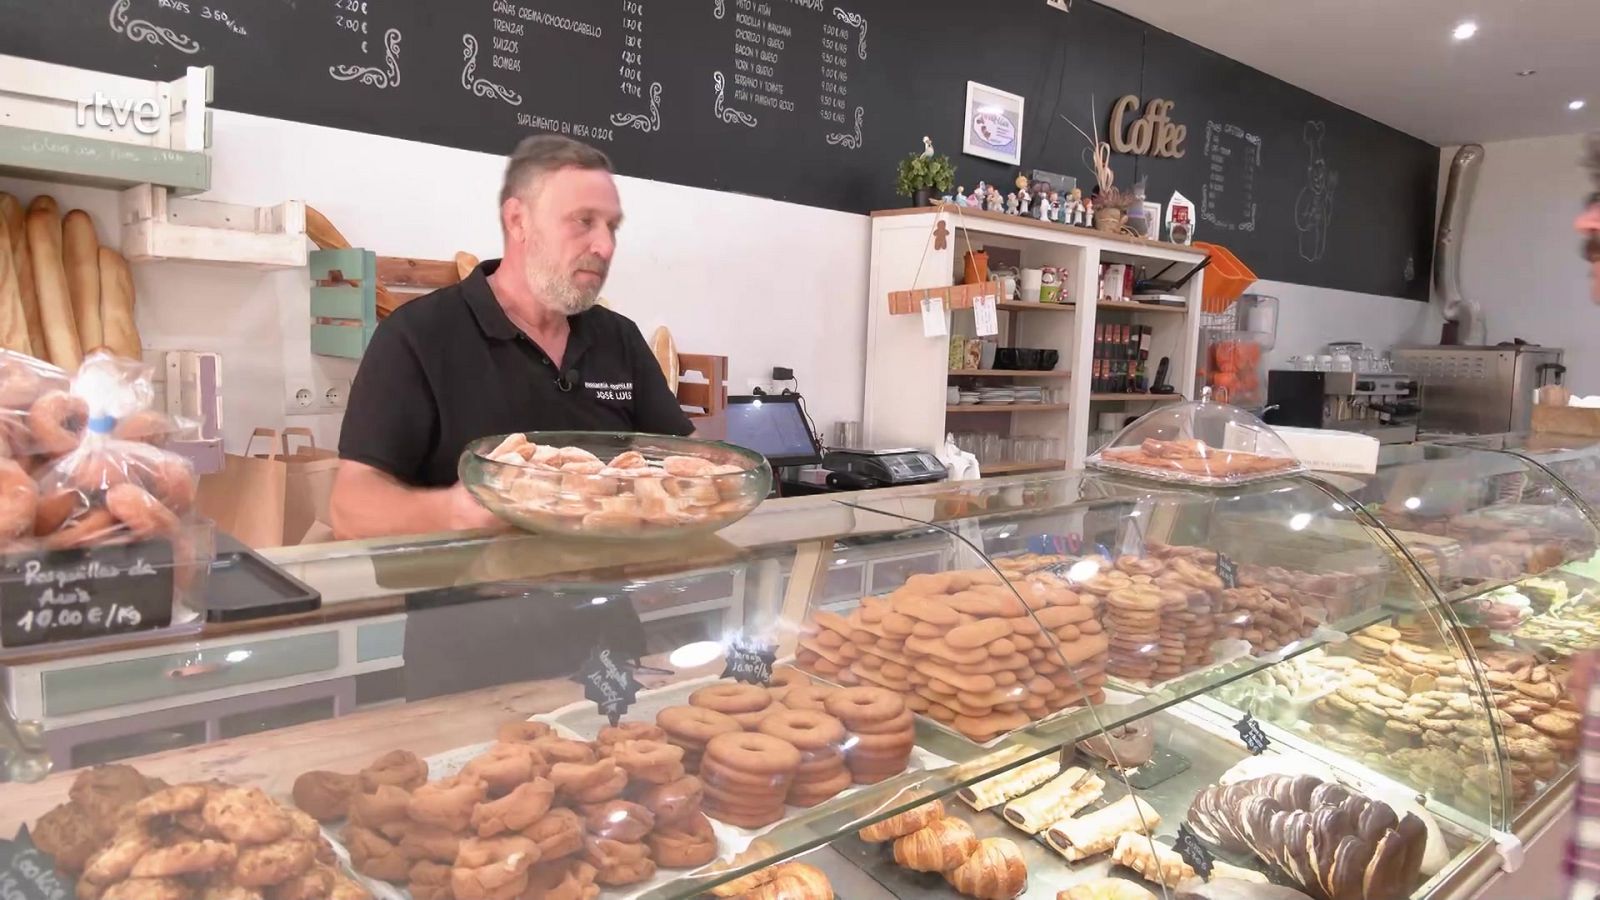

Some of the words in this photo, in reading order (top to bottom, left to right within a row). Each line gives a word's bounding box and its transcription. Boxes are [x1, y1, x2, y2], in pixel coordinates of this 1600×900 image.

[493, 0, 515, 16] CAÑAS
[753, 2, 757, 12] Y
[493, 18, 524, 36] TRENZAS
[762, 21, 766, 29] Y
[493, 37, 518, 53] SUIZOS
[735, 28, 760, 43] CHORIZO
[762, 36, 766, 45] Y
[767, 37, 784, 50] QUESO
[735, 43, 753, 57] BACON
[755, 49, 759, 58] Y
[760, 50, 778, 63] QUESO
[493, 55, 520, 72] BOMBAS
[735, 58, 748, 71] YORK
[750, 63, 754, 72] Y
[755, 64, 773, 77] QUESO
[517, 113, 559, 132] SUPLEMENTO
[561, 122, 571, 134] EN
[573, 125, 589, 137] MESA
[1109, 94, 1187, 158] Coffee
[615, 391, 632, 400] LUIS
